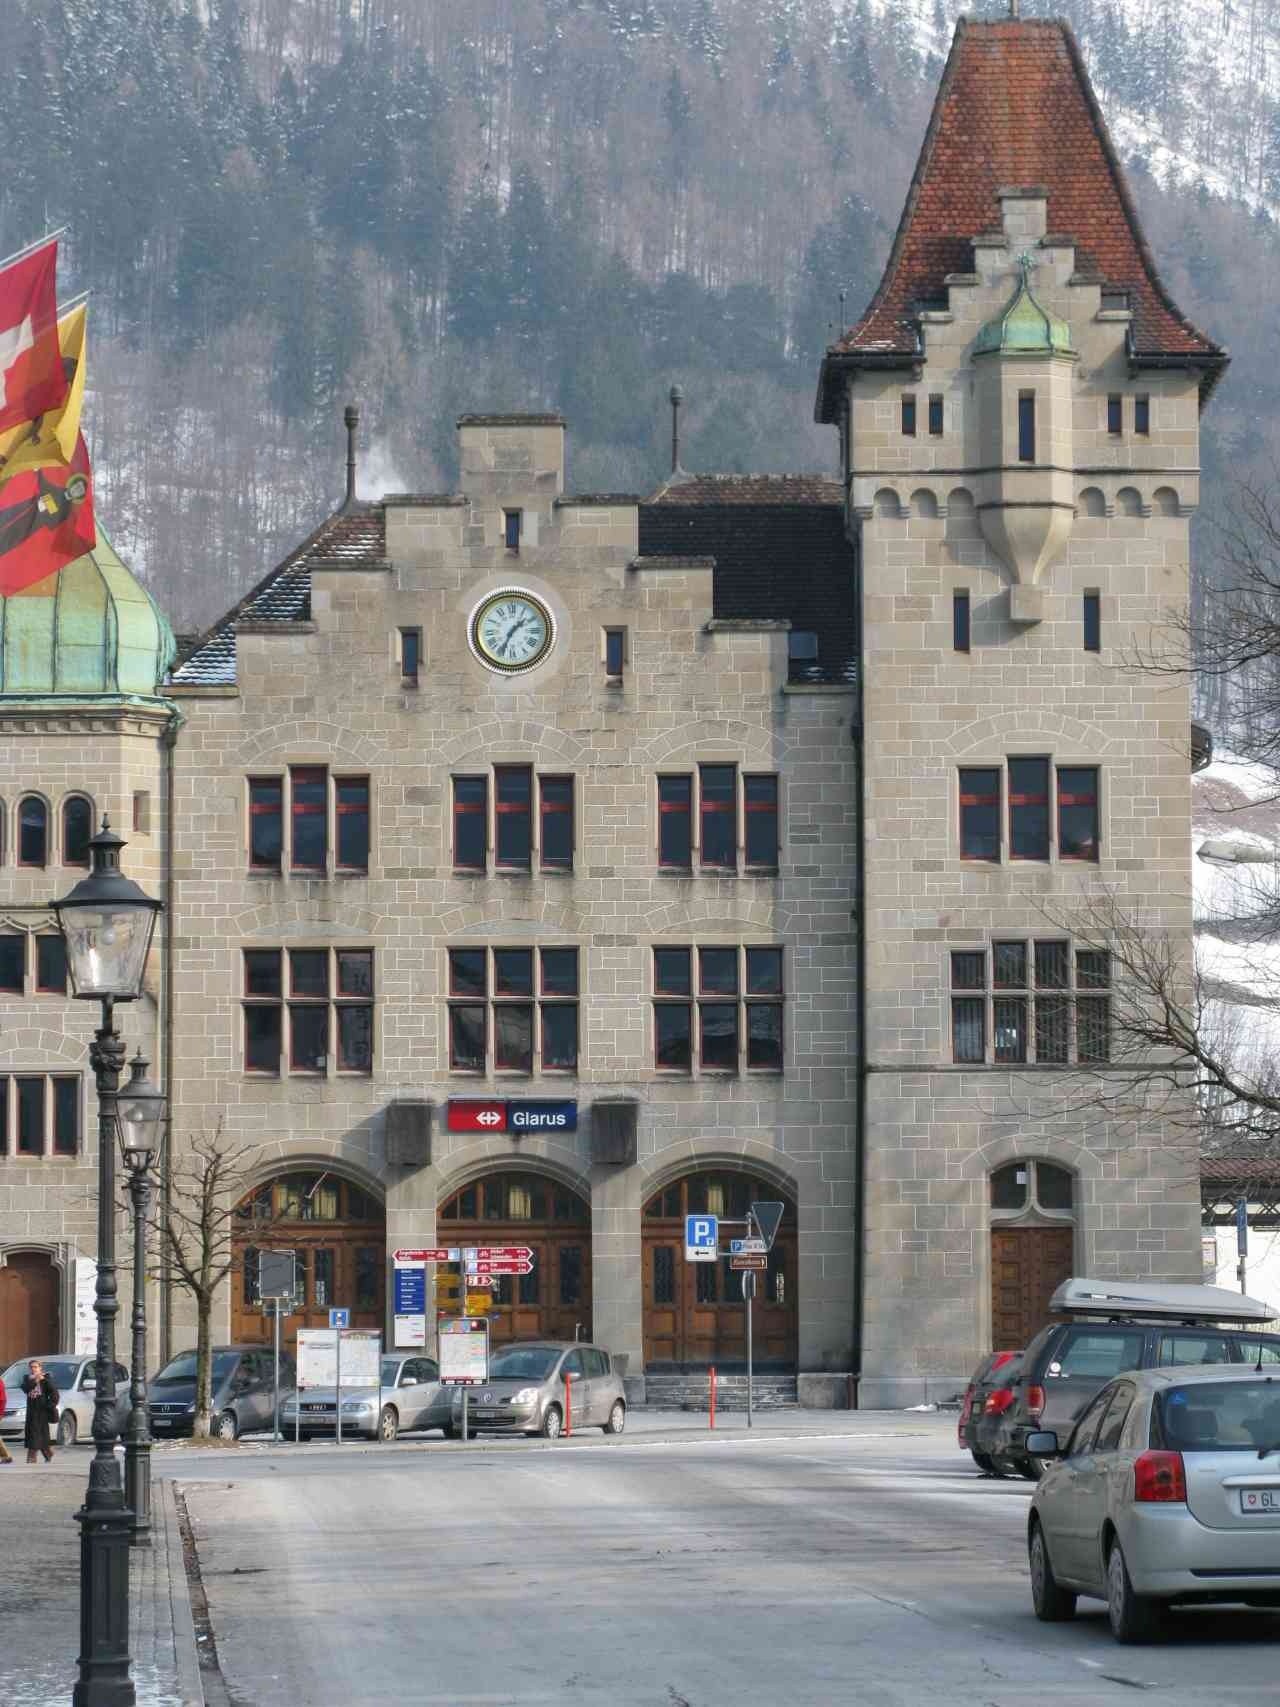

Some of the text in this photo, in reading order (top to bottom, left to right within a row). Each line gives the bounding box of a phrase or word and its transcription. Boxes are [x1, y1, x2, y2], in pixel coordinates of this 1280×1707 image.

[513, 1112, 566, 1126] Glarus
[695, 1222, 709, 1244] P
[1261, 1492, 1280, 1507] GL
